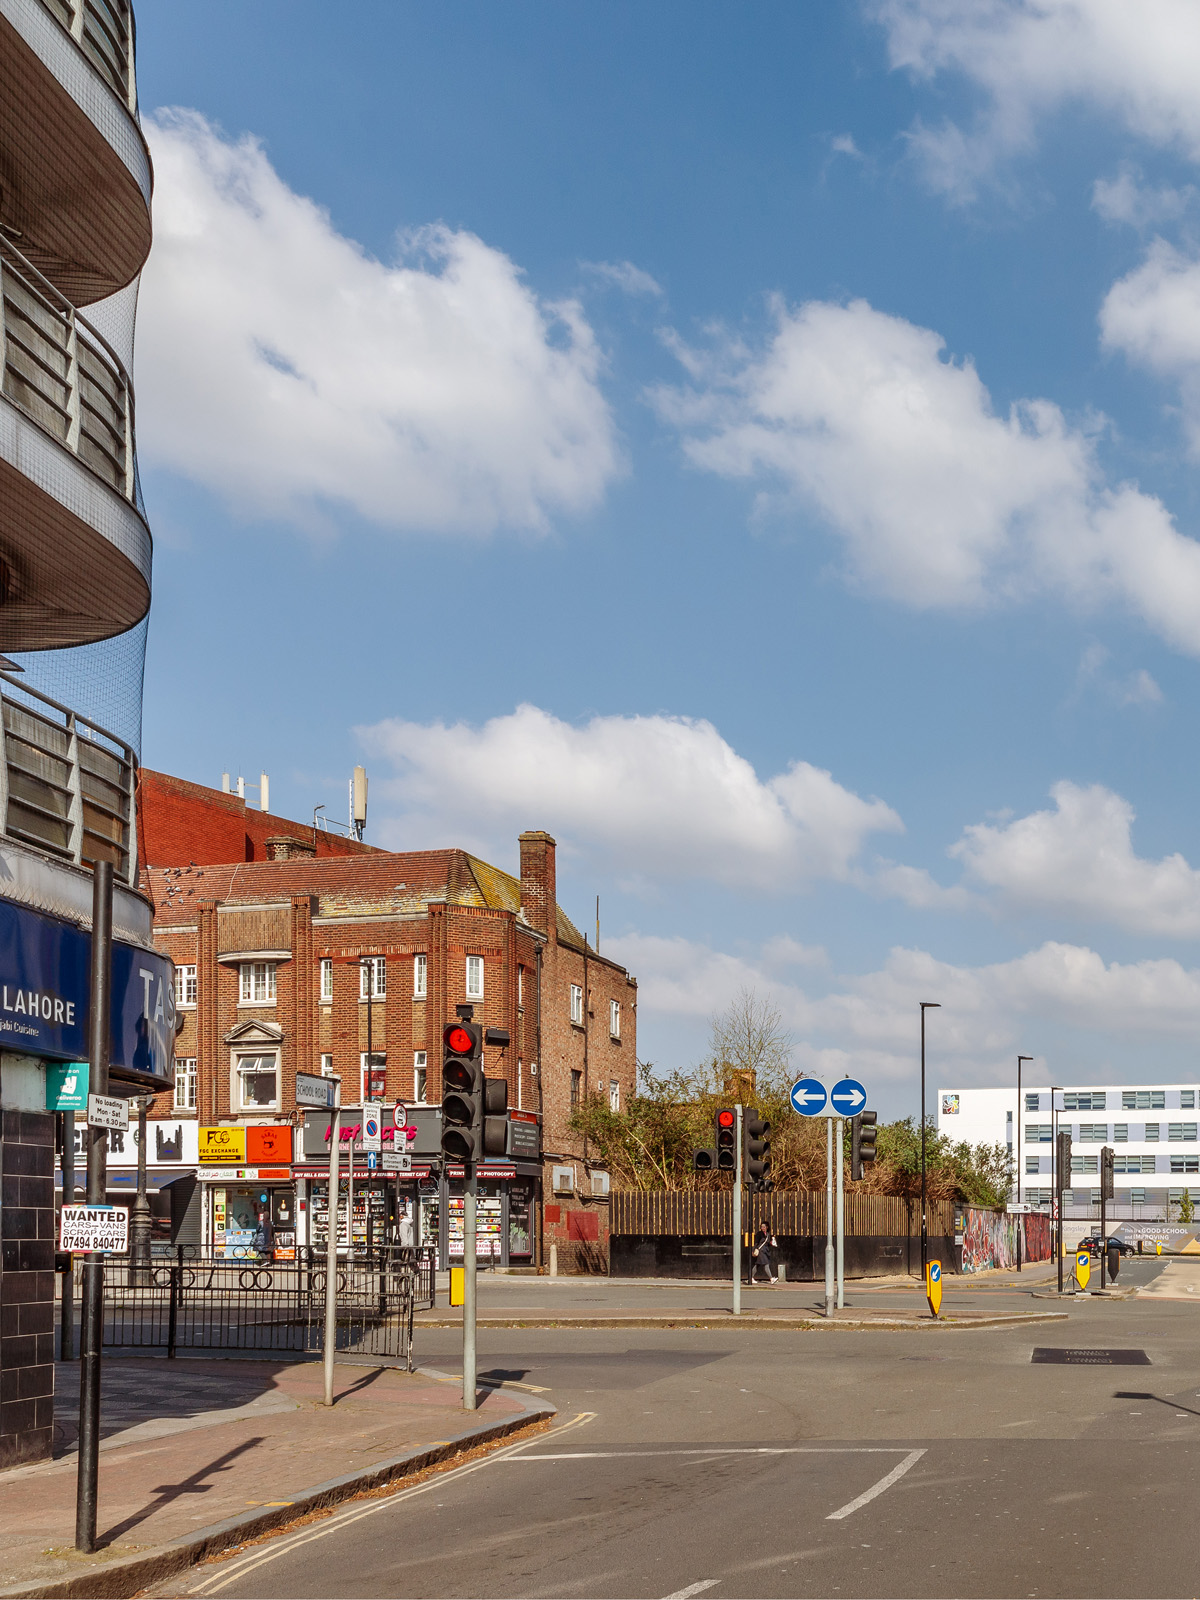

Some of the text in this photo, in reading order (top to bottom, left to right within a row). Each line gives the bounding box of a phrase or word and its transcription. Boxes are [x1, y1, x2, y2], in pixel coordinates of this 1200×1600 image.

[3, 985, 76, 1026] LAHORE
[139, 968, 176, 1030] TAS
[13, 1021, 39, 1036] Cuisine
[297, 1084, 327, 1099] SCHOOL ROAD
[104, 1099, 123, 1109] loading
[97, 1108, 121, 1118] Mon Sat
[119, 1120, 127, 1128] pm
[64, 1210, 126, 1222] WANTED
[63, 1236, 125, 1249] 07494 840477
